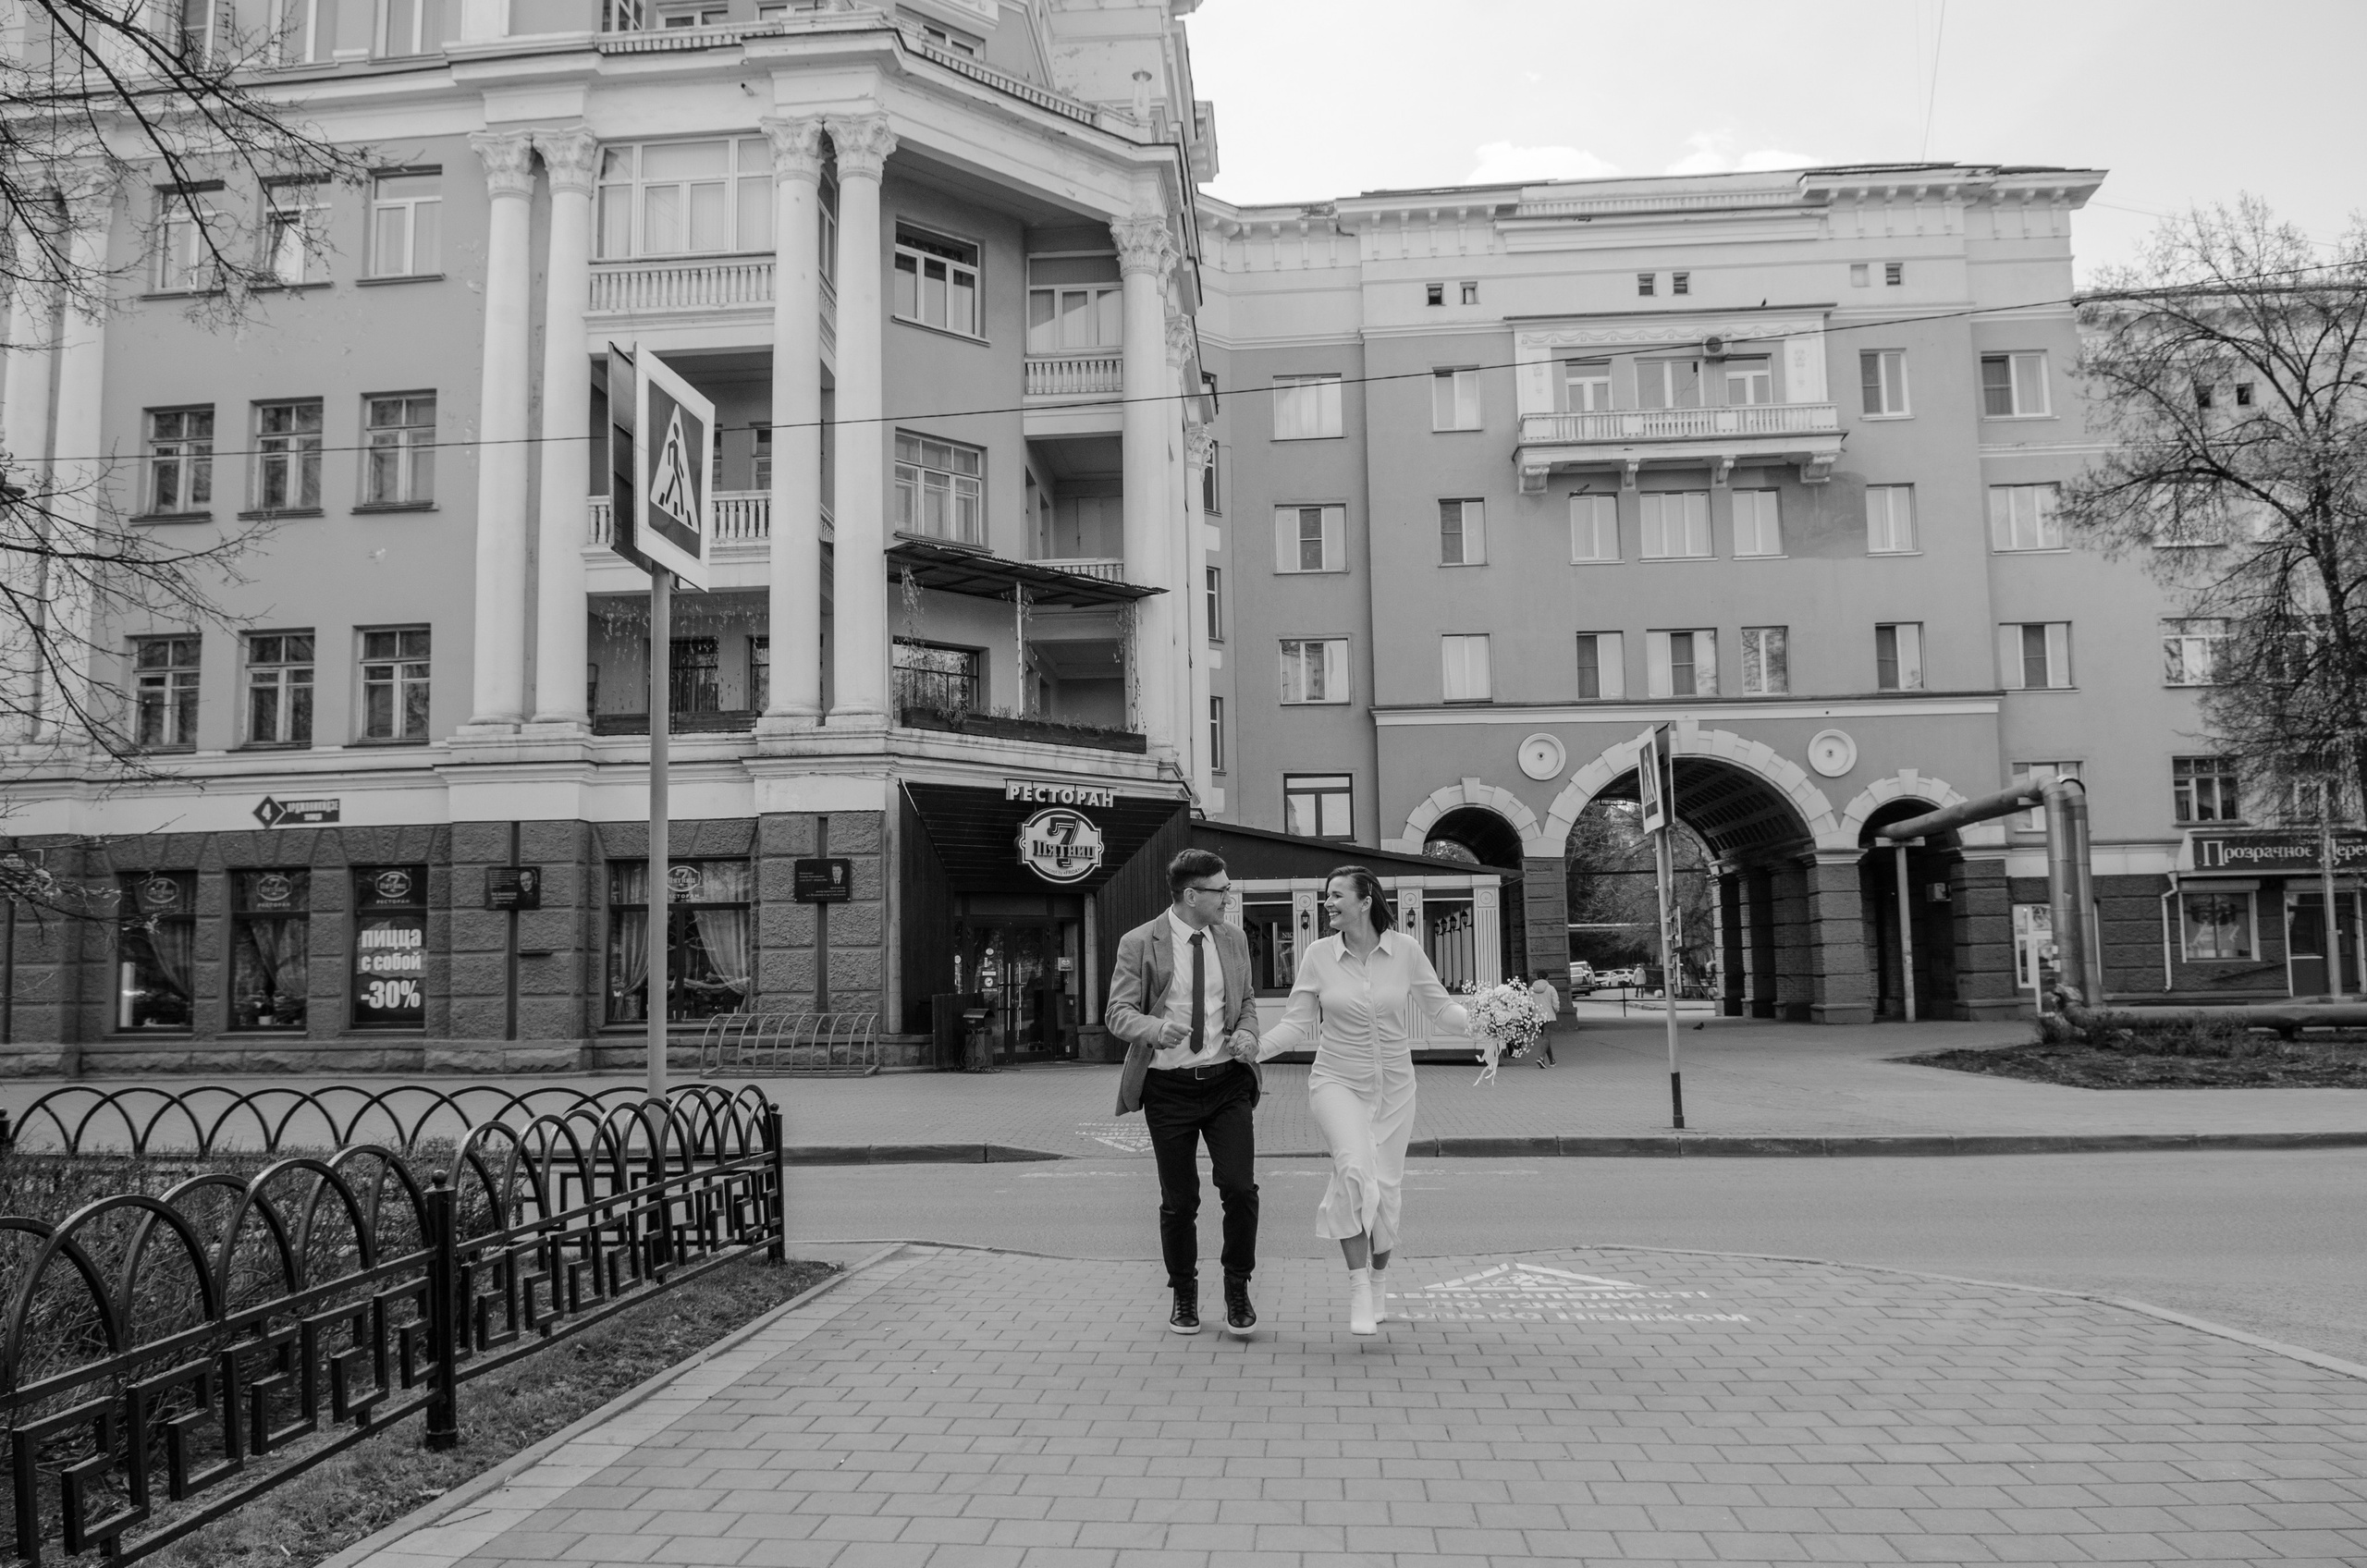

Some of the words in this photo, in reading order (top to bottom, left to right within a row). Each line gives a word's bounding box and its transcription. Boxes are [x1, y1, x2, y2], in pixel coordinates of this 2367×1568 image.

[1006, 785, 1113, 807] РЕСТОРАН
[261, 803, 272, 820] 4
[1047, 817, 1082, 867] 7
[2201, 840, 2313, 866] Прозрачное
[2318, 839, 2367, 865] Дере
[386, 875, 400, 892] 7
[675, 869, 689, 887] 7
[362, 929, 423, 950] пицца
[361, 956, 372, 971] с
[374, 951, 422, 971] собой
[361, 980, 421, 1009] -30%
[1555, 1312, 1751, 1322] ПЕШКОМ
